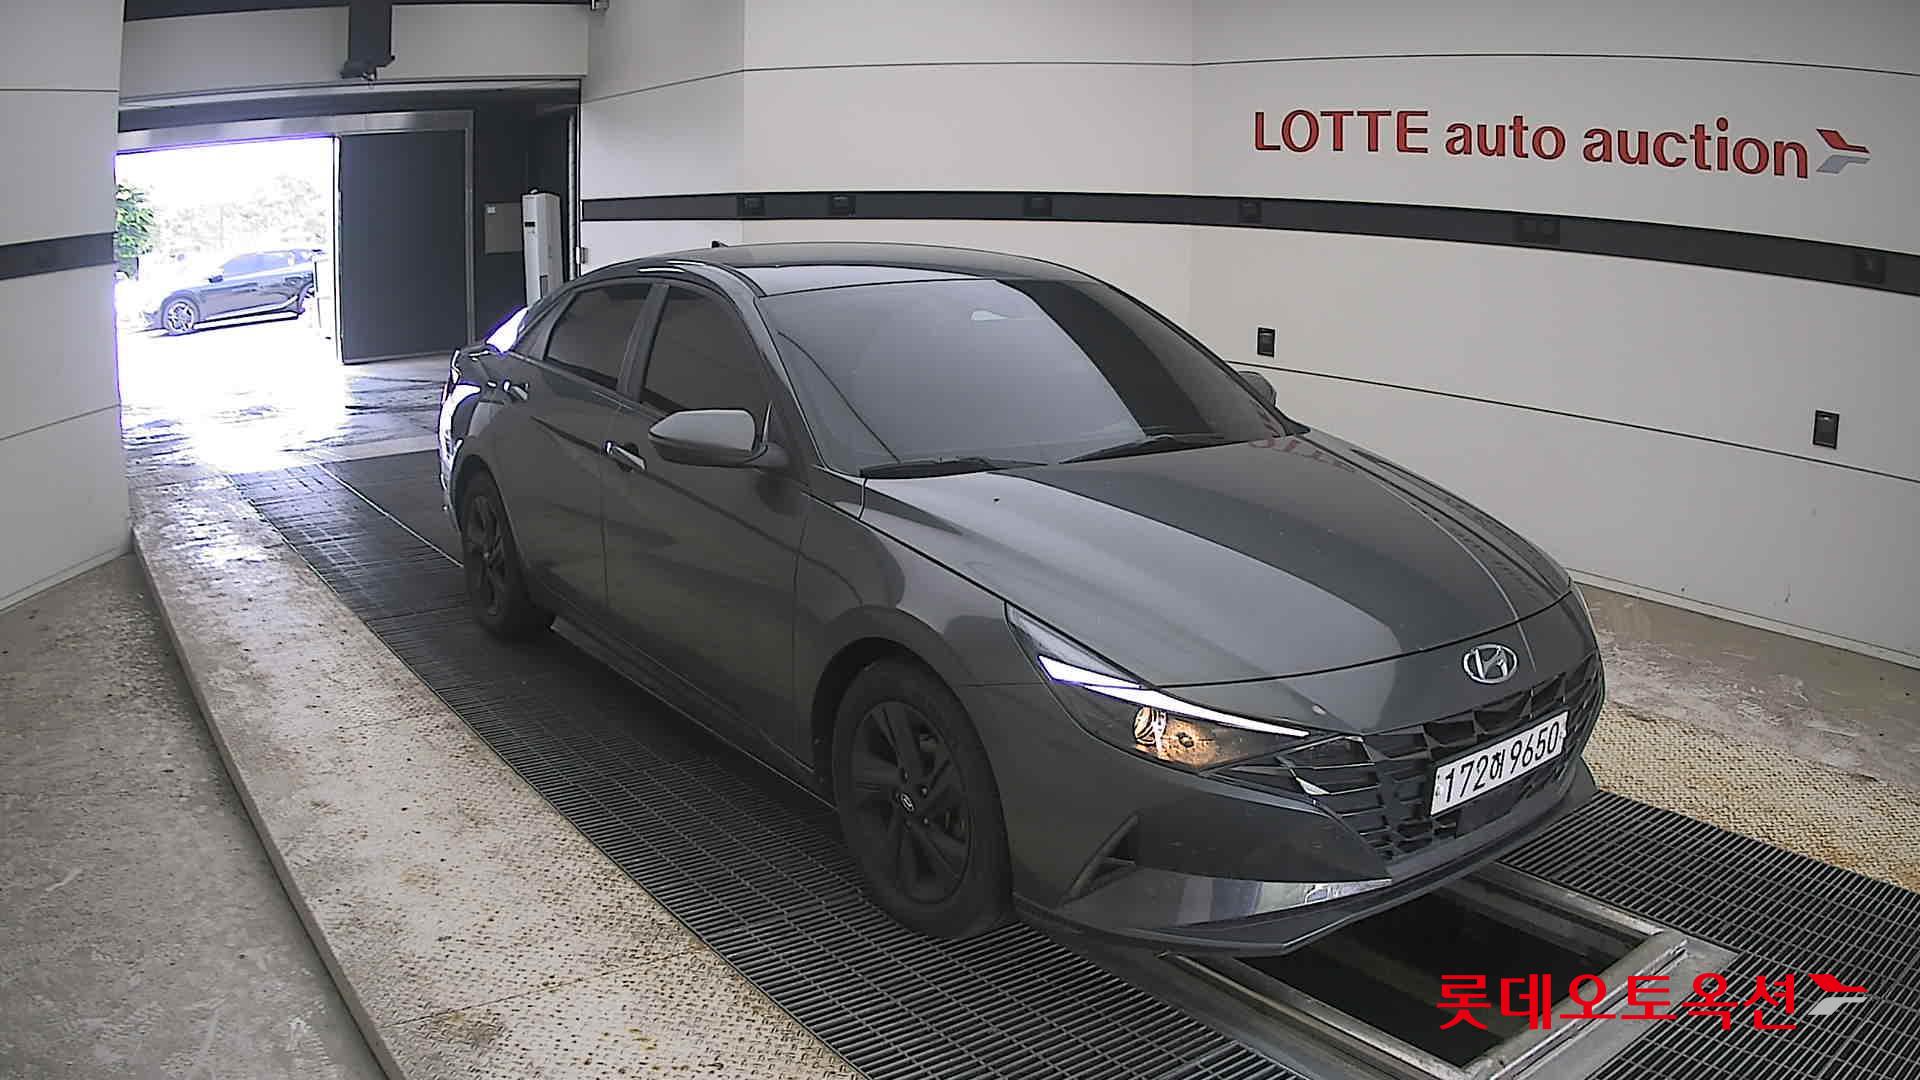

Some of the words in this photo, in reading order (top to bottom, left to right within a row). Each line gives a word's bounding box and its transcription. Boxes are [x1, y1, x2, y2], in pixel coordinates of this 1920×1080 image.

[1254, 110, 1429, 153] LOTTE
[1445, 115, 1566, 160] auto
[1583, 117, 1809, 179] auction
[1510, 720, 1561, 775] 9650
